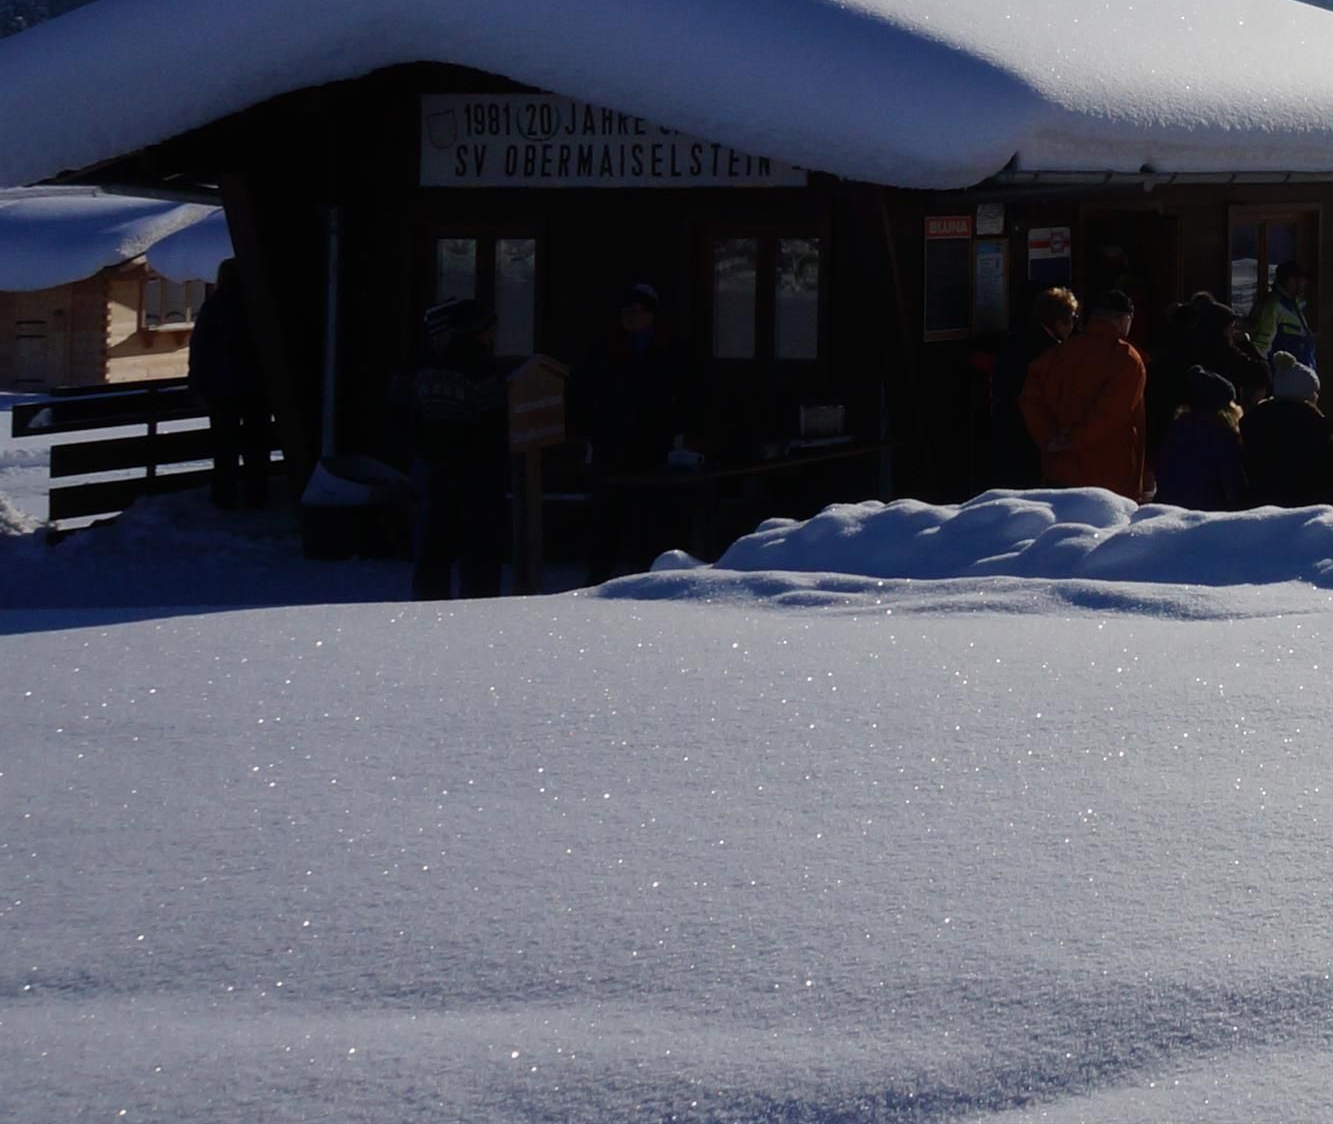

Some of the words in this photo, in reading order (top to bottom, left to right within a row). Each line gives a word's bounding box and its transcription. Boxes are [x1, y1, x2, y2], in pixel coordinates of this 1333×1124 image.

[464, 103, 511, 136] 1981
[526, 103, 552, 136] 20
[455, 143, 487, 177] SV
[505, 143, 771, 177] OBERMAISELSTEIN
